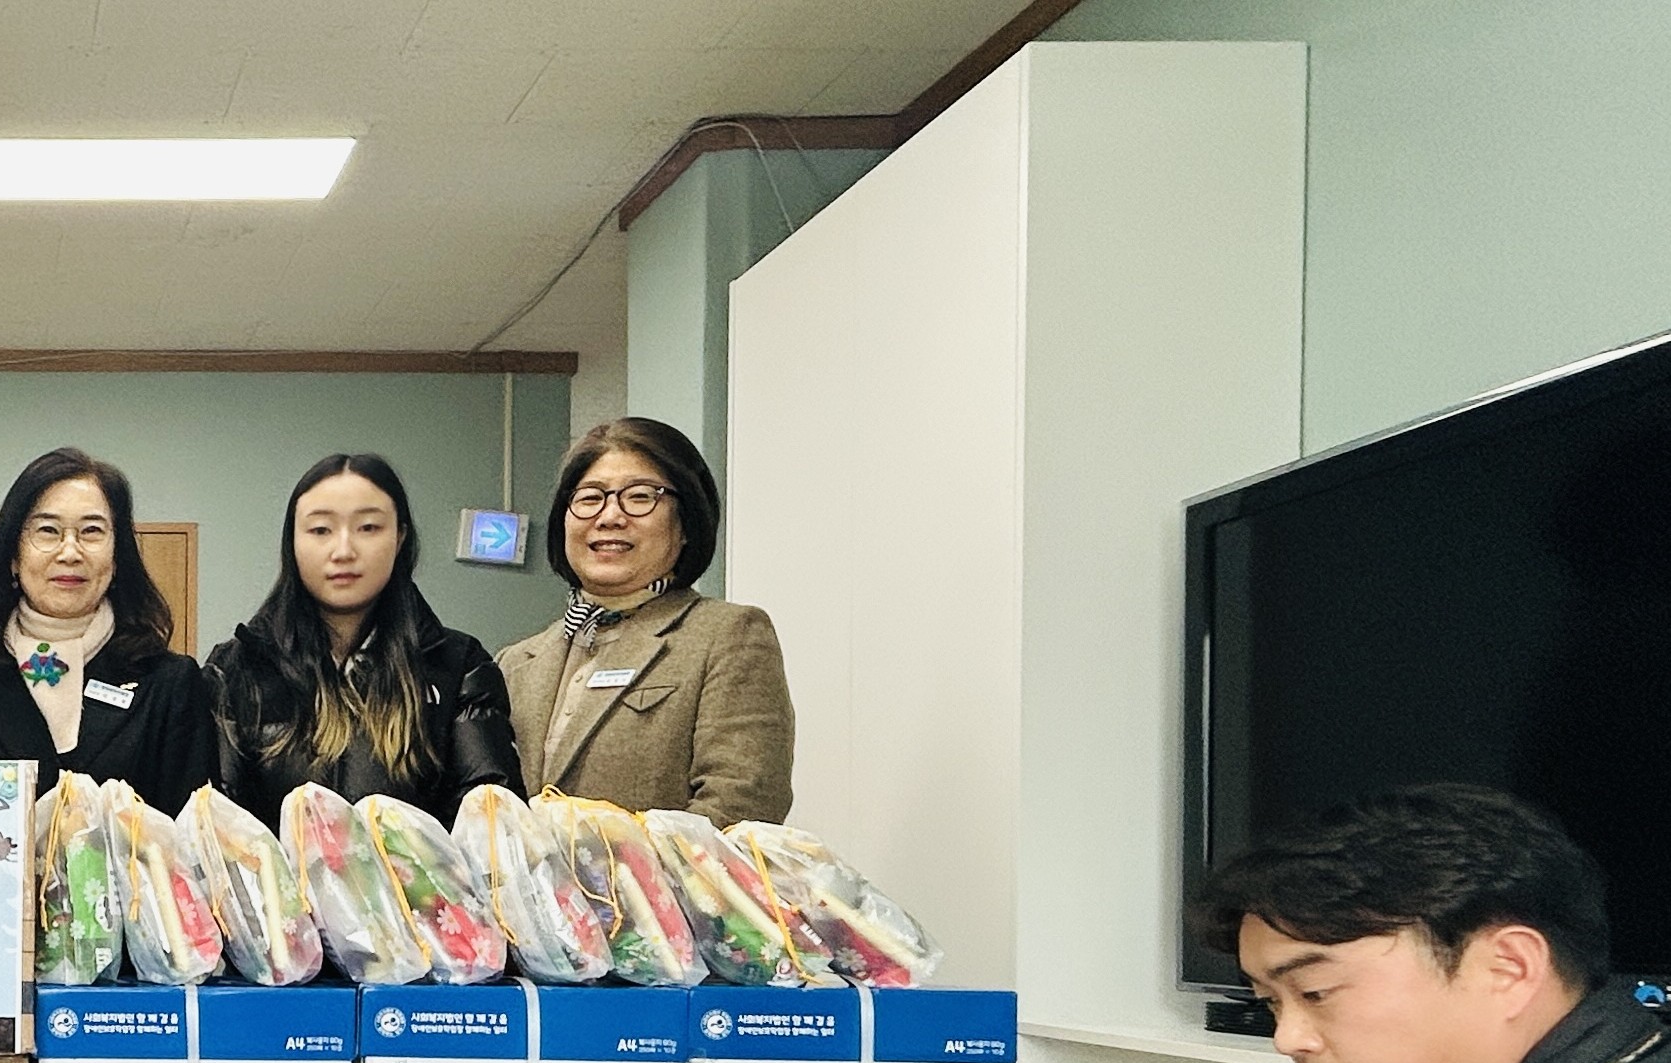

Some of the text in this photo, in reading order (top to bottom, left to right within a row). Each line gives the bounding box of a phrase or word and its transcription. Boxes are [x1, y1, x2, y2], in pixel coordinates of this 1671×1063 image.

[285, 1036, 306, 1051] A4
[617, 1038, 638, 1052] A4
[944, 1040, 966, 1054] A4
